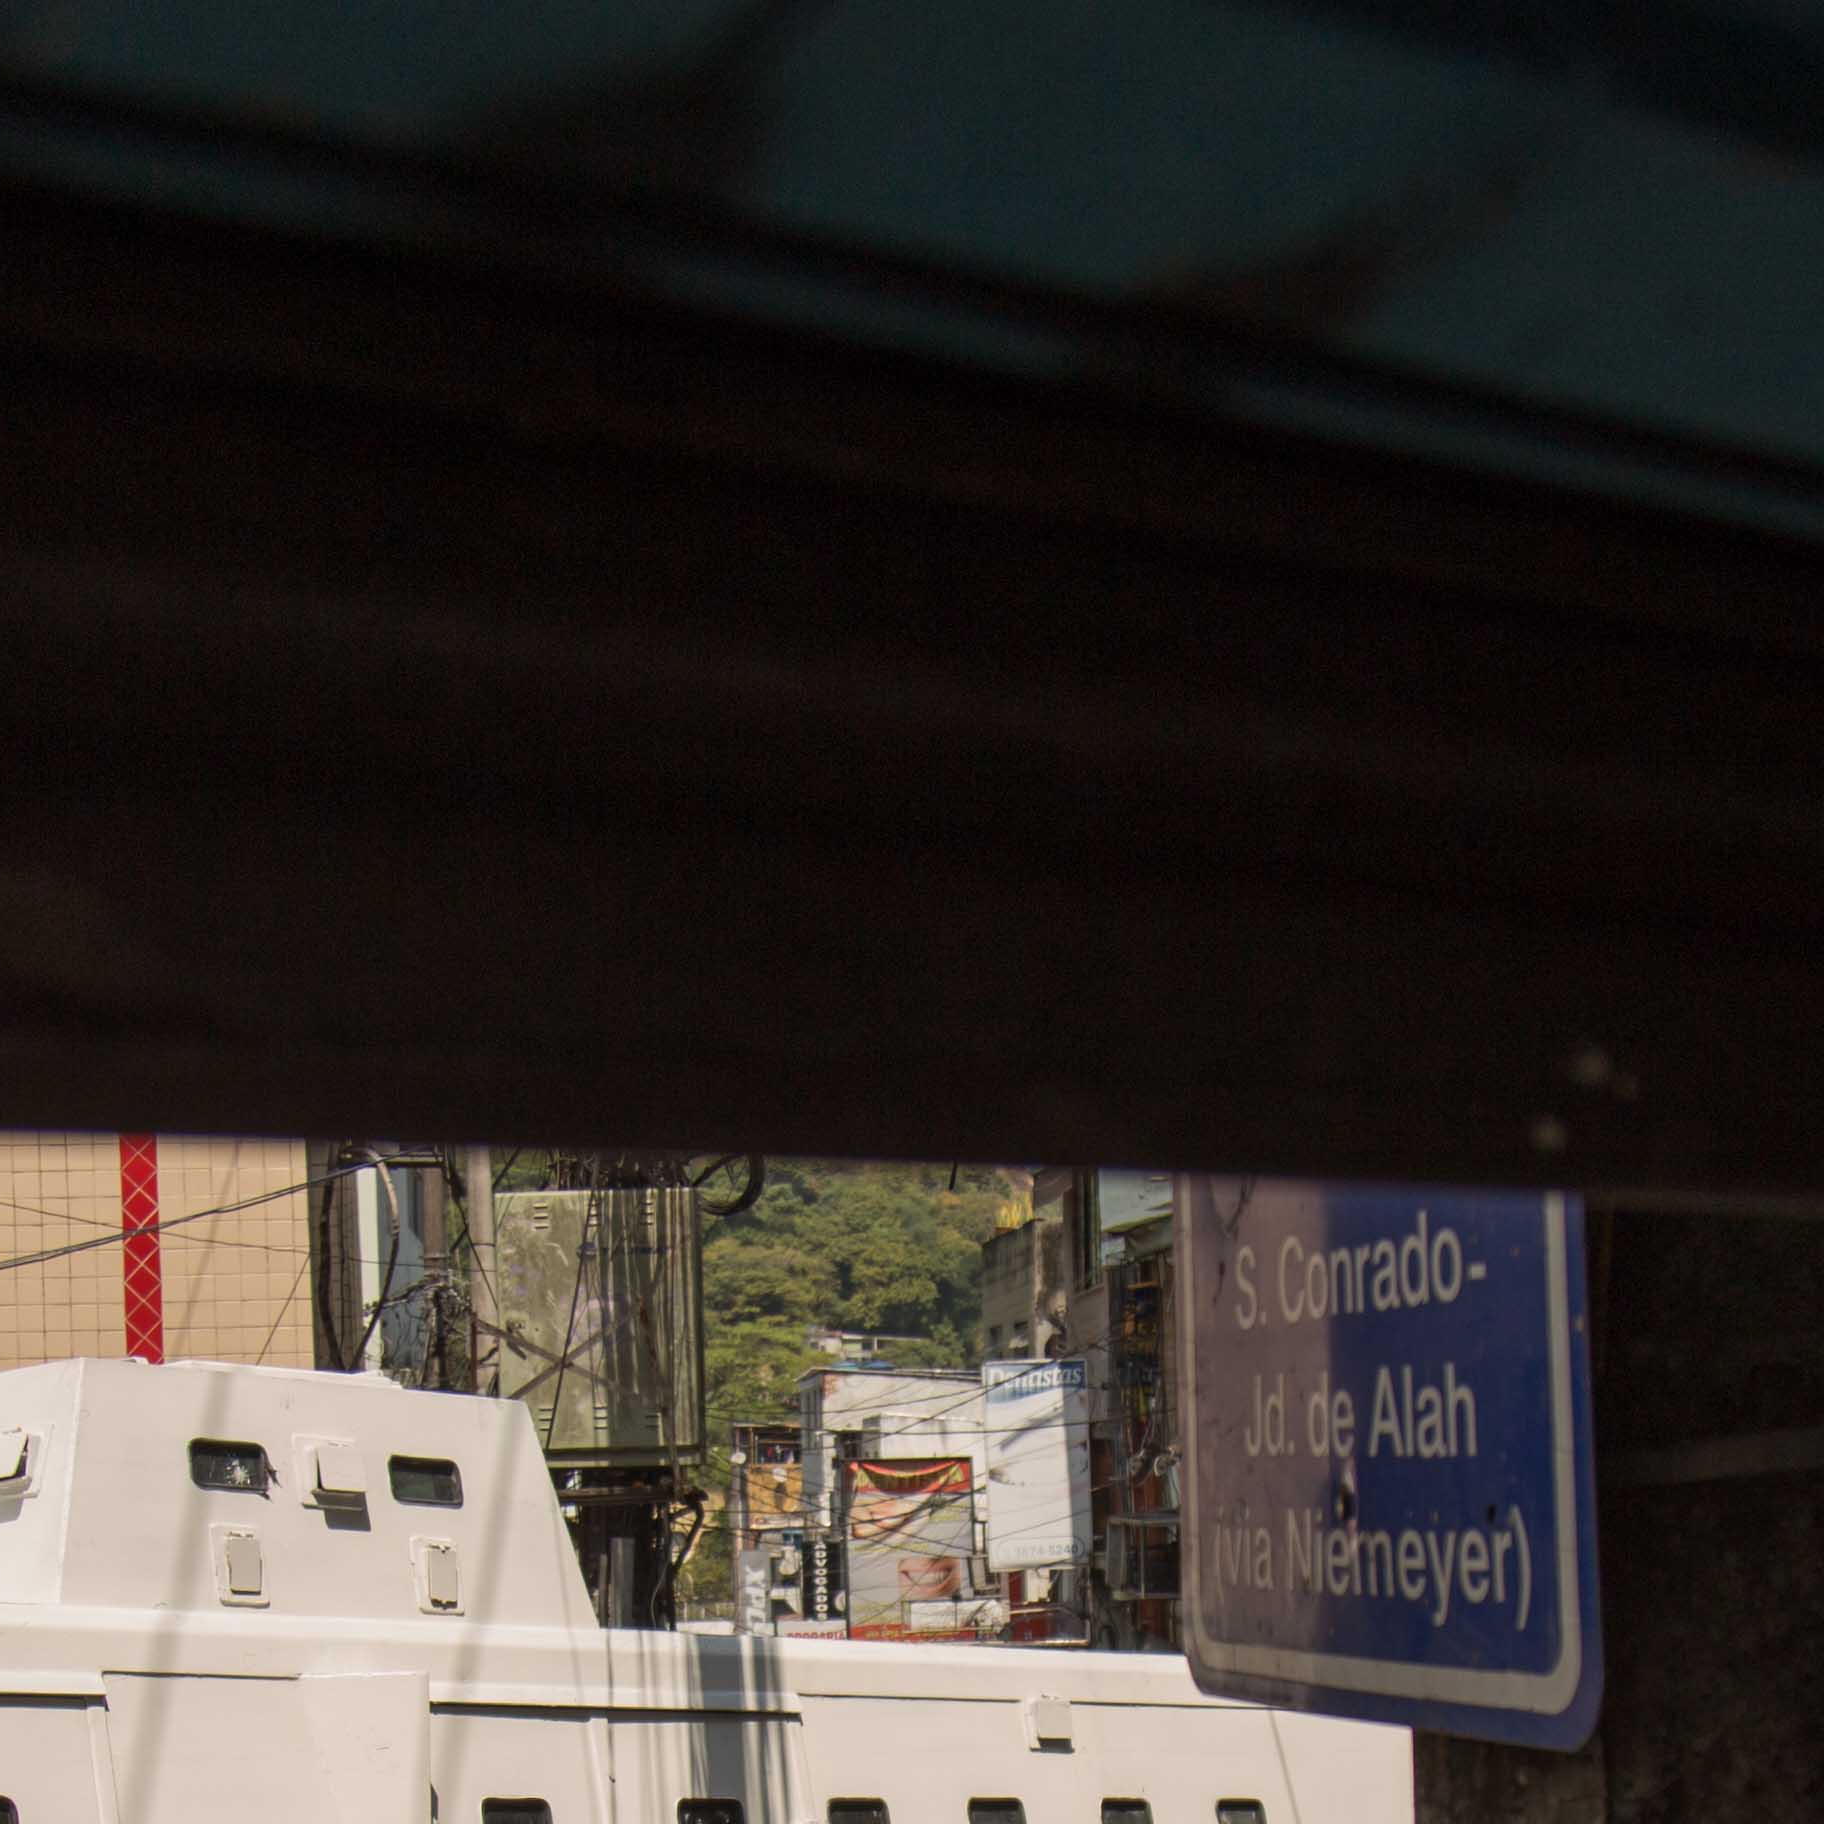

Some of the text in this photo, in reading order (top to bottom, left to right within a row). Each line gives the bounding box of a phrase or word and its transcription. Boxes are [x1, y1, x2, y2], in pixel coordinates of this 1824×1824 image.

[1234, 1244, 1268, 1331] S.
[1243, 1361, 1478, 1459] Jd. de Alah
[1212, 1504, 1533, 1632] (via Niemeyer)
